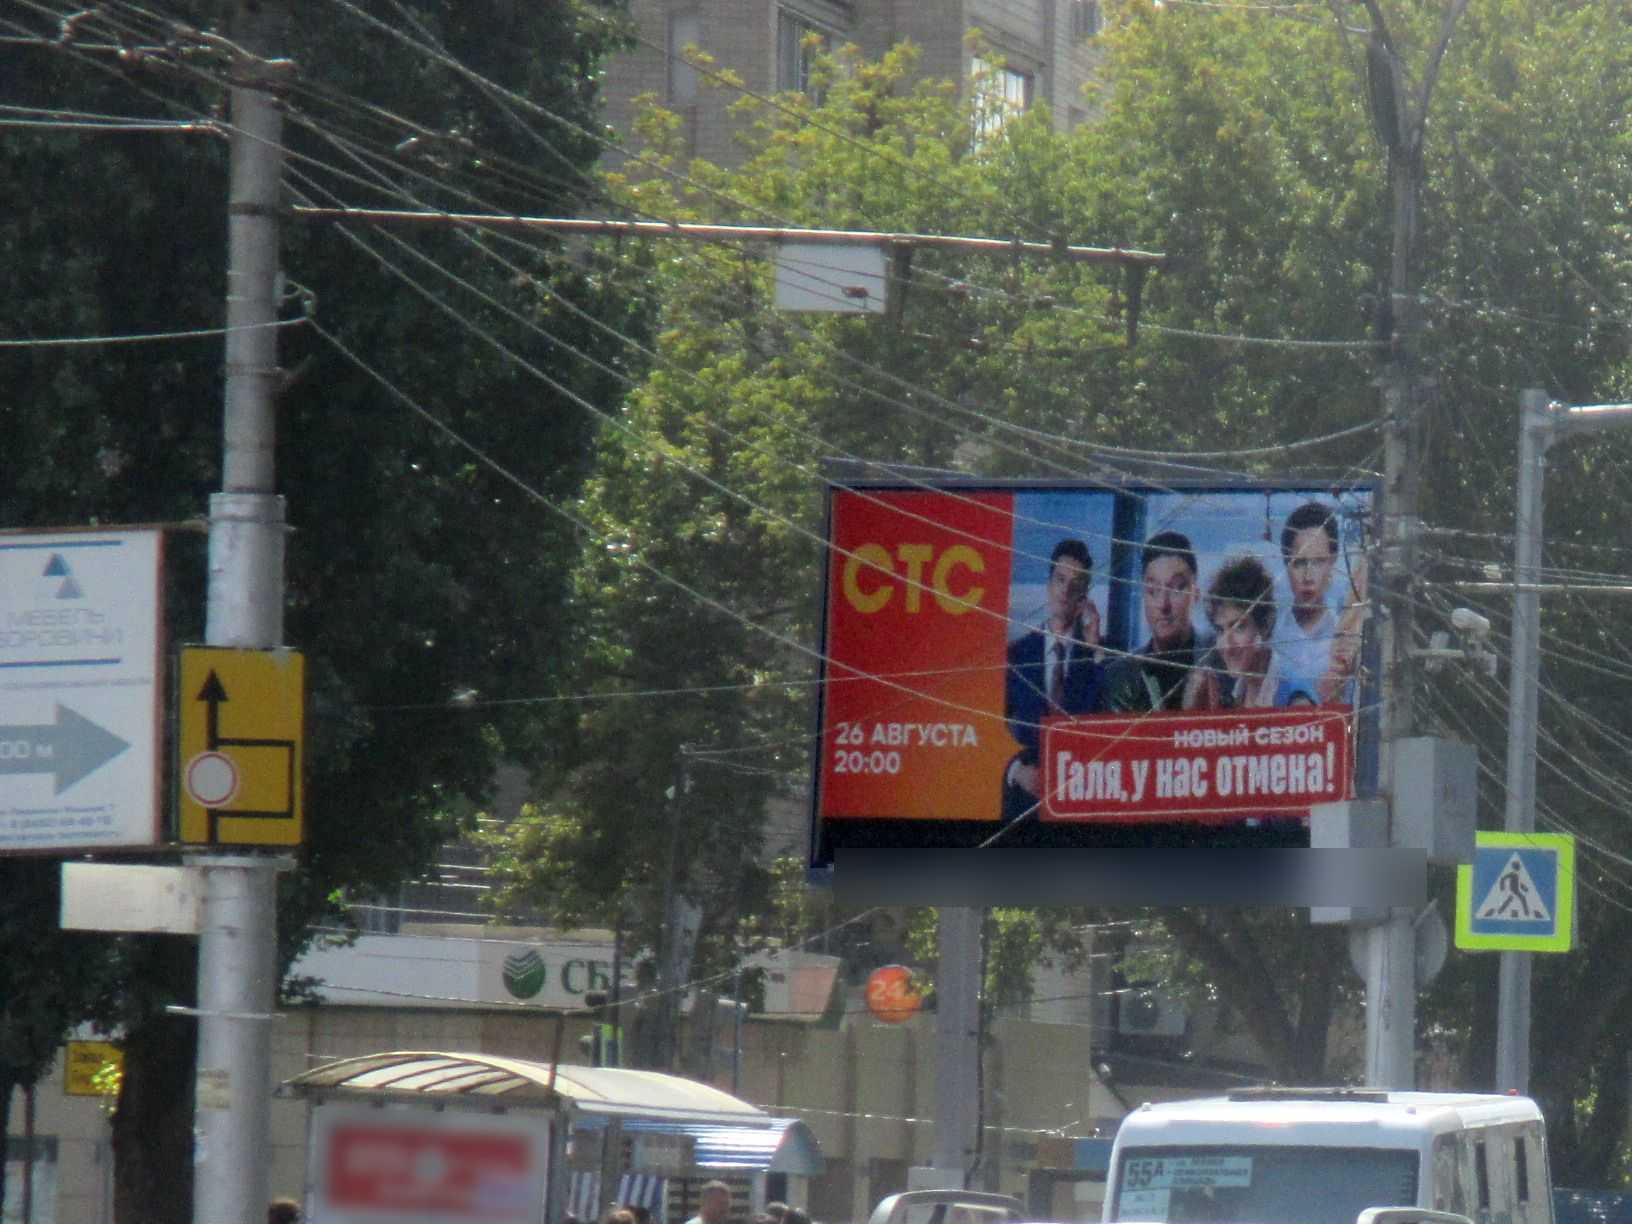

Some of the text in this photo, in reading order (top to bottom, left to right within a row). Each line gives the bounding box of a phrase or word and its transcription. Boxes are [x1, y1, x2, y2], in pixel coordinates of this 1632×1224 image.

[843, 543, 985, 615] СТС
[834, 721, 978, 747] 26 АВГУСТА
[1174, 724, 1325, 748] НОВЫЙ СЕЗОН
[834, 749, 901, 774] 20:00
[1156, 757, 1209, 798] нас
[1216, 741, 1336, 797] отмена!
